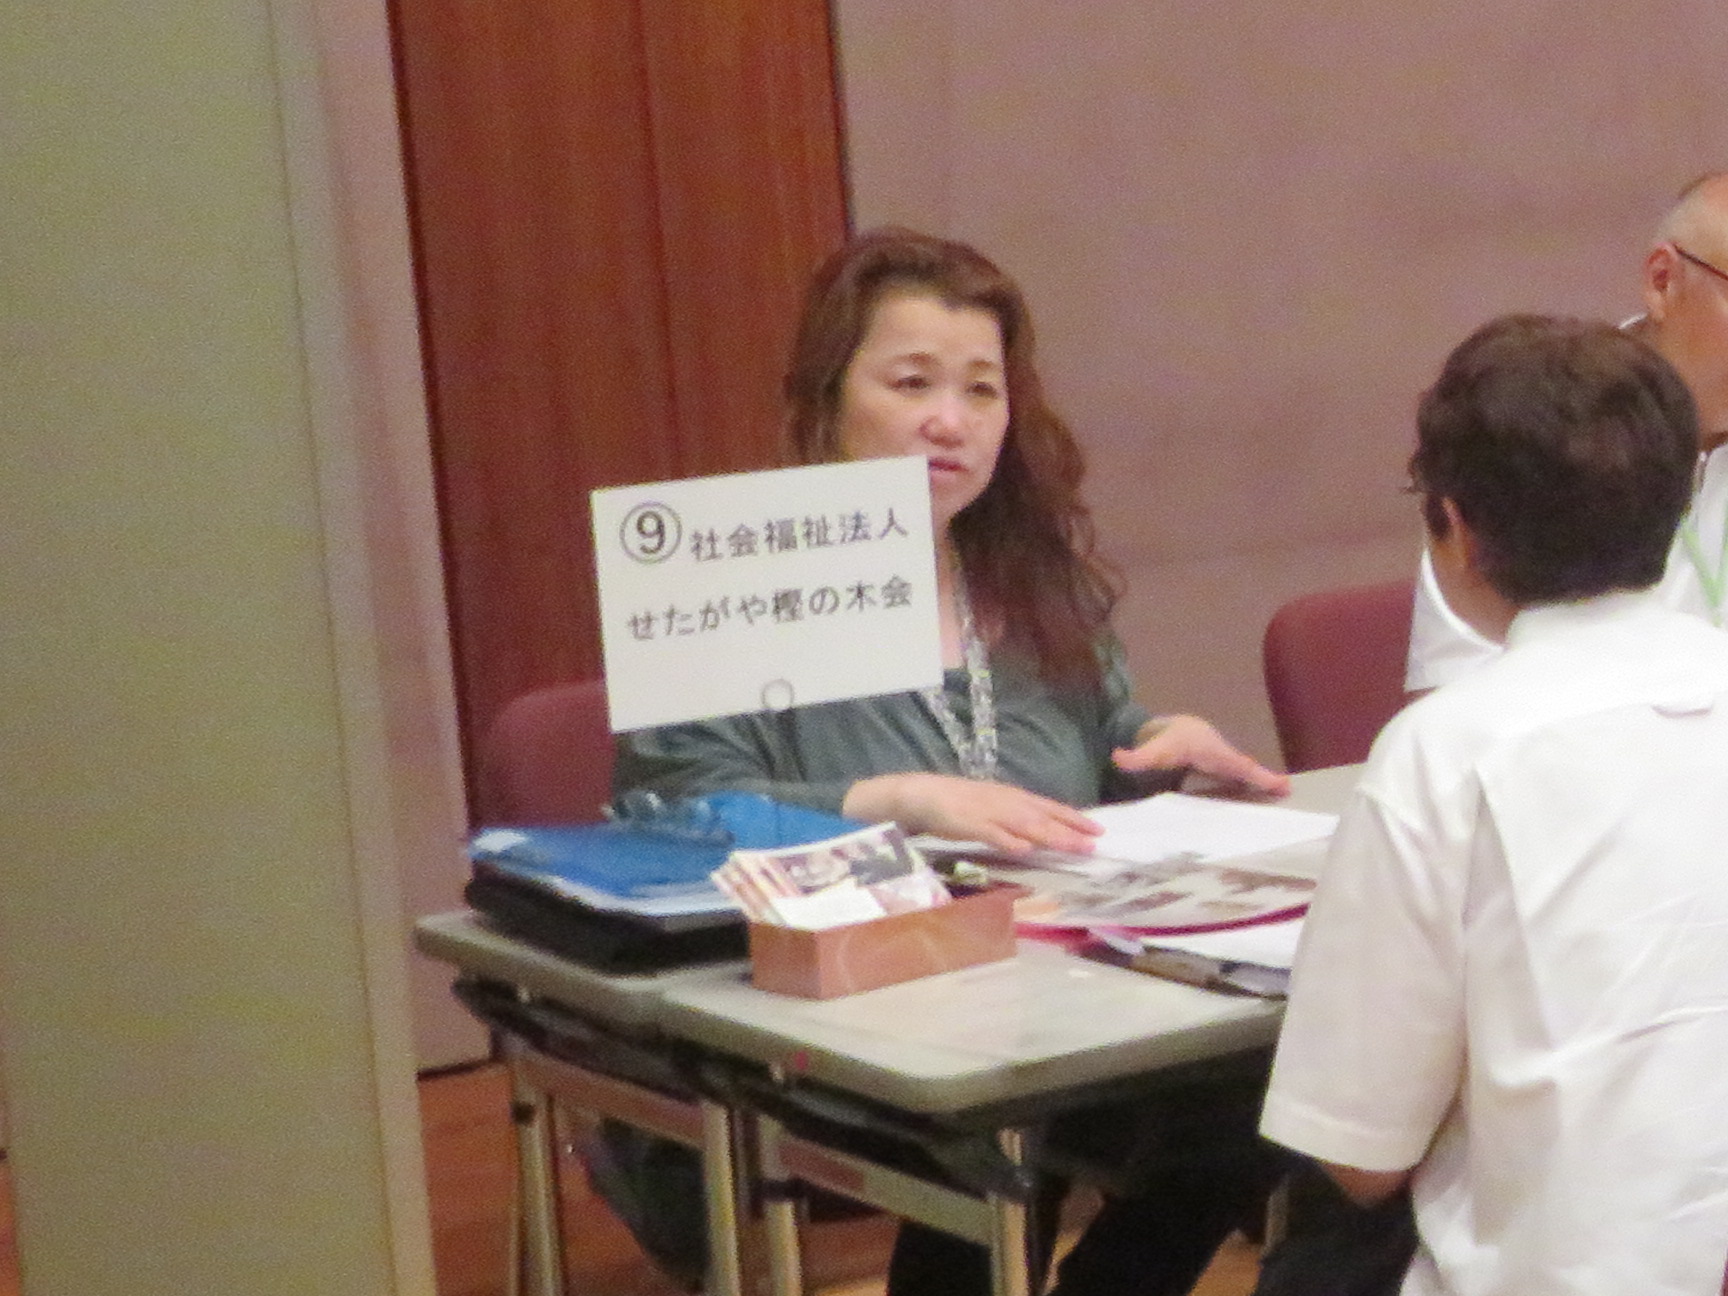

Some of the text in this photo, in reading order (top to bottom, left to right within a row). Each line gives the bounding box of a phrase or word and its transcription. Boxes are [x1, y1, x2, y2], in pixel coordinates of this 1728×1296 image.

[628, 573, 912, 640] せたがや樫の木会
